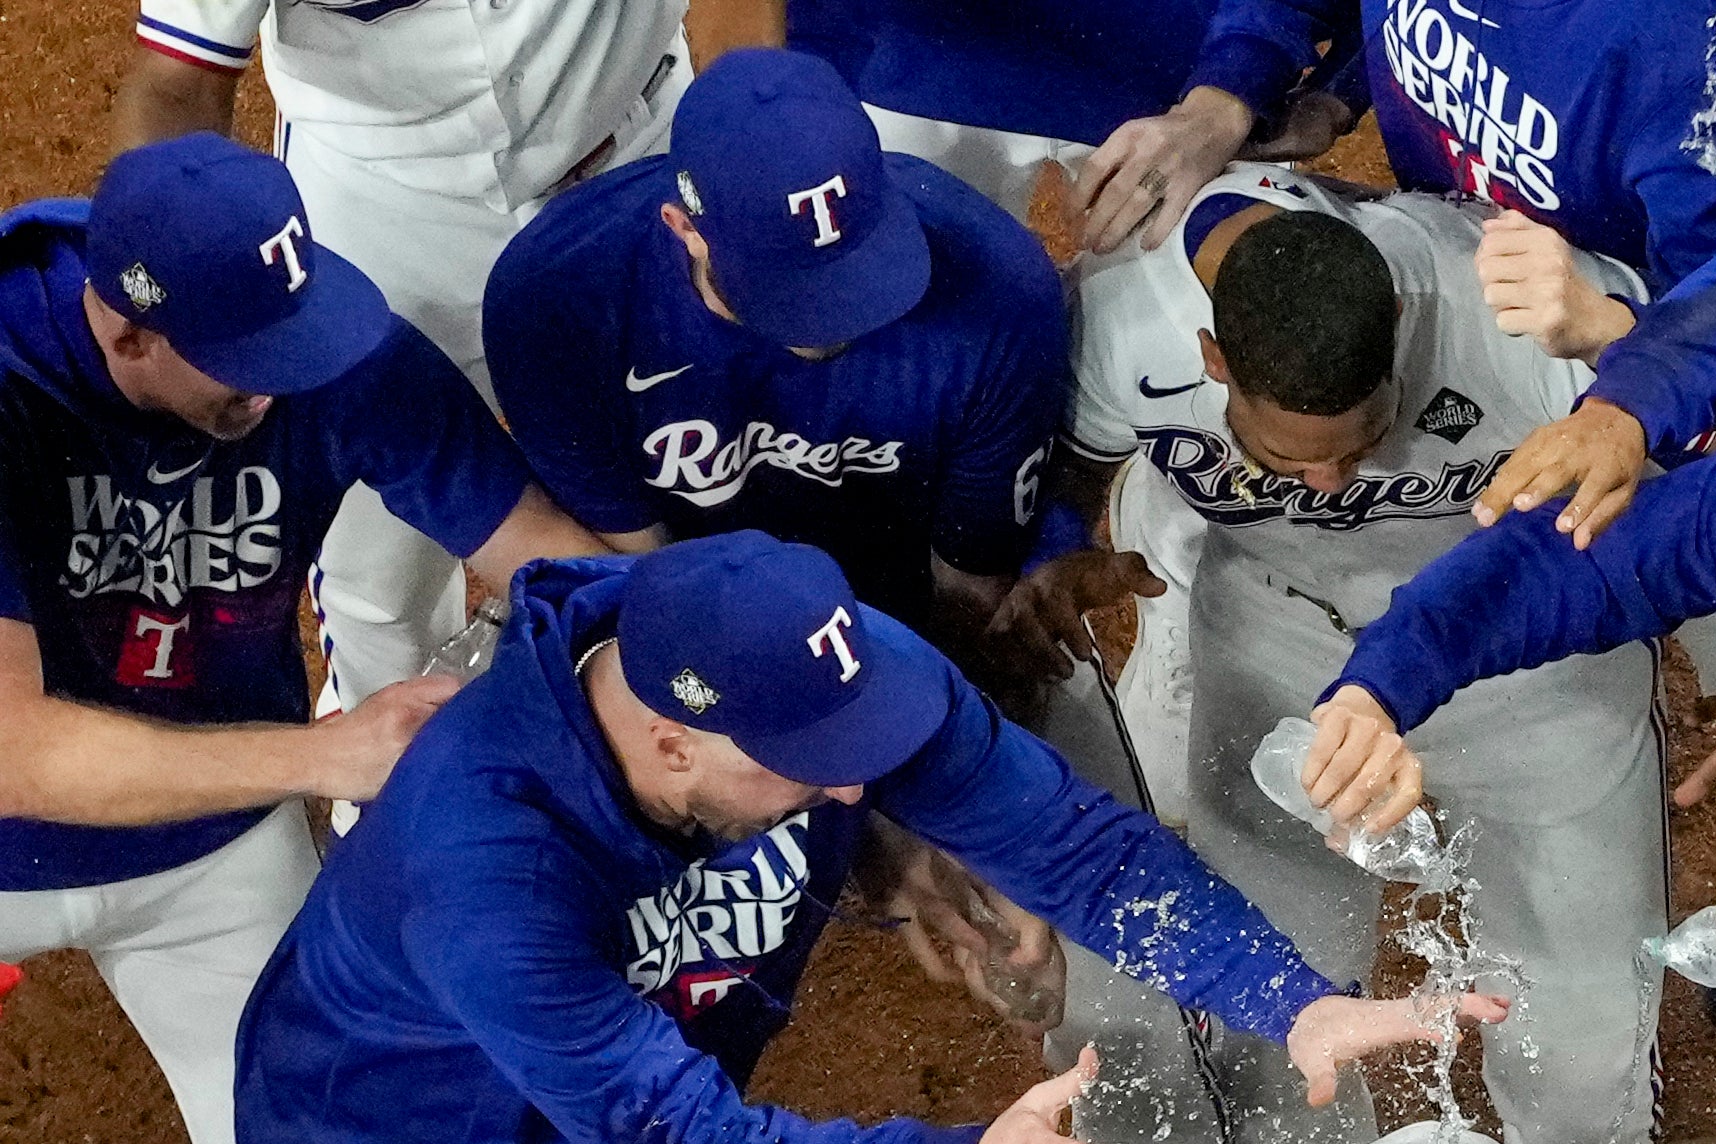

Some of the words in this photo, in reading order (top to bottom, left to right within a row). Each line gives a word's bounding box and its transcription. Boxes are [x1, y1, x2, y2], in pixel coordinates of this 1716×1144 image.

[1383, 18, 1560, 210] SERIES
[788, 175, 846, 247] T
[259, 216, 308, 293] T
[643, 419, 904, 507] Rangers
[1134, 425, 1516, 532] Ranger
[136, 613, 190, 678] T
[807, 606, 861, 683] T
